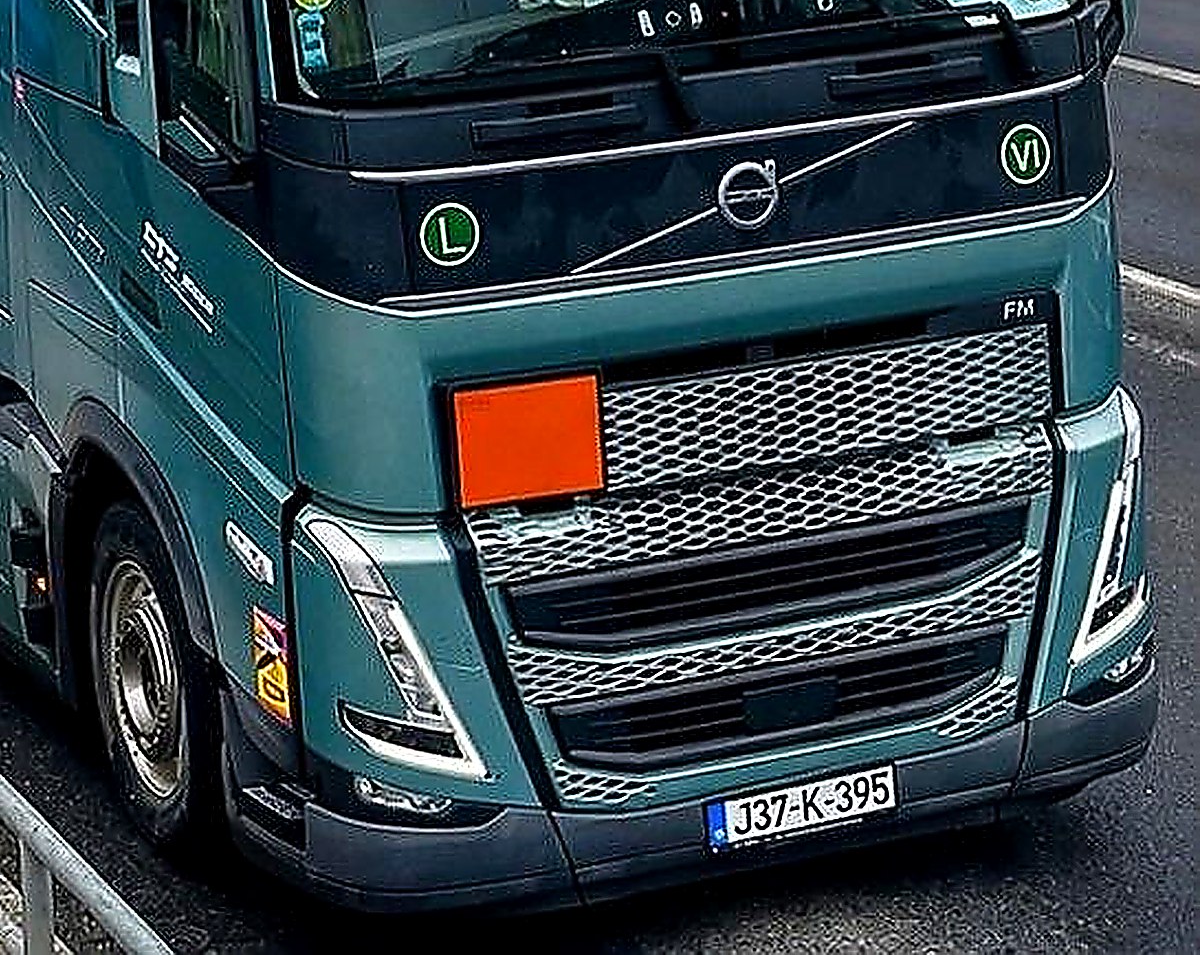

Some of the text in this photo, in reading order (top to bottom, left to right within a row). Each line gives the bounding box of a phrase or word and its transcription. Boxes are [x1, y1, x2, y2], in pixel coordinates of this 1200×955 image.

[1011, 138, 1040, 172] VI
[438, 216, 468, 255] L
[1003, 298, 1034, 320] FM
[734, 771, 890, 835] J37-K-395
